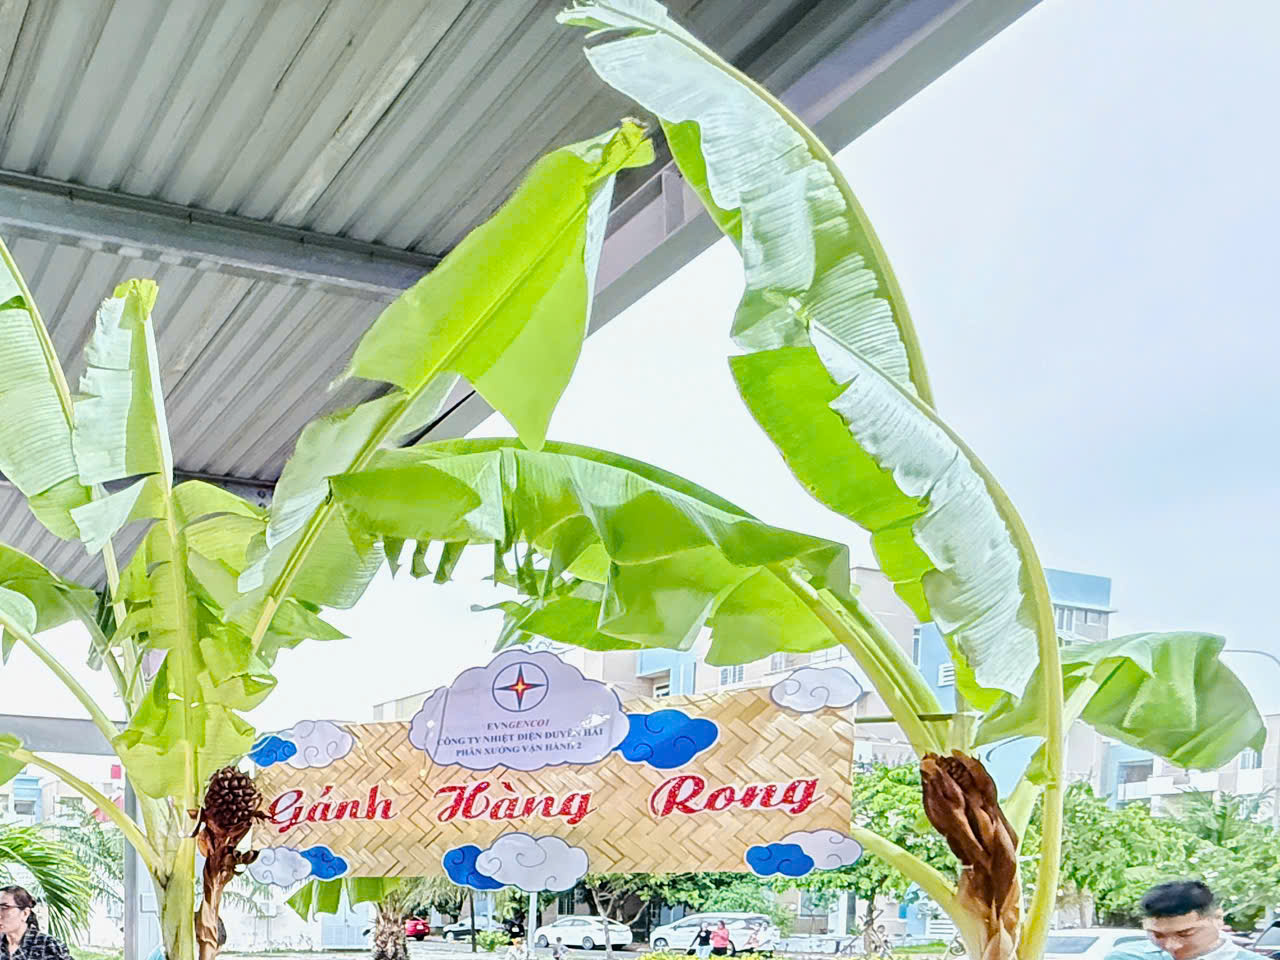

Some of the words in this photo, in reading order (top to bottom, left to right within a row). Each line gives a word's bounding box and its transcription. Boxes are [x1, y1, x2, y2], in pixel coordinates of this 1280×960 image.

[487, 718, 551, 730] EVNGENCO1
[437, 735, 466, 746] CÔNG
[468, 736, 481, 744] TY
[483, 733, 515, 744] NHIỆT
[544, 727, 581, 739] DUYÊN
[456, 747, 482, 757] PHÂN
[576, 741, 583, 750] 2
[269, 784, 399, 834] Gánh
[433, 780, 599, 825] Hàng
[651, 775, 825, 818] Rong
